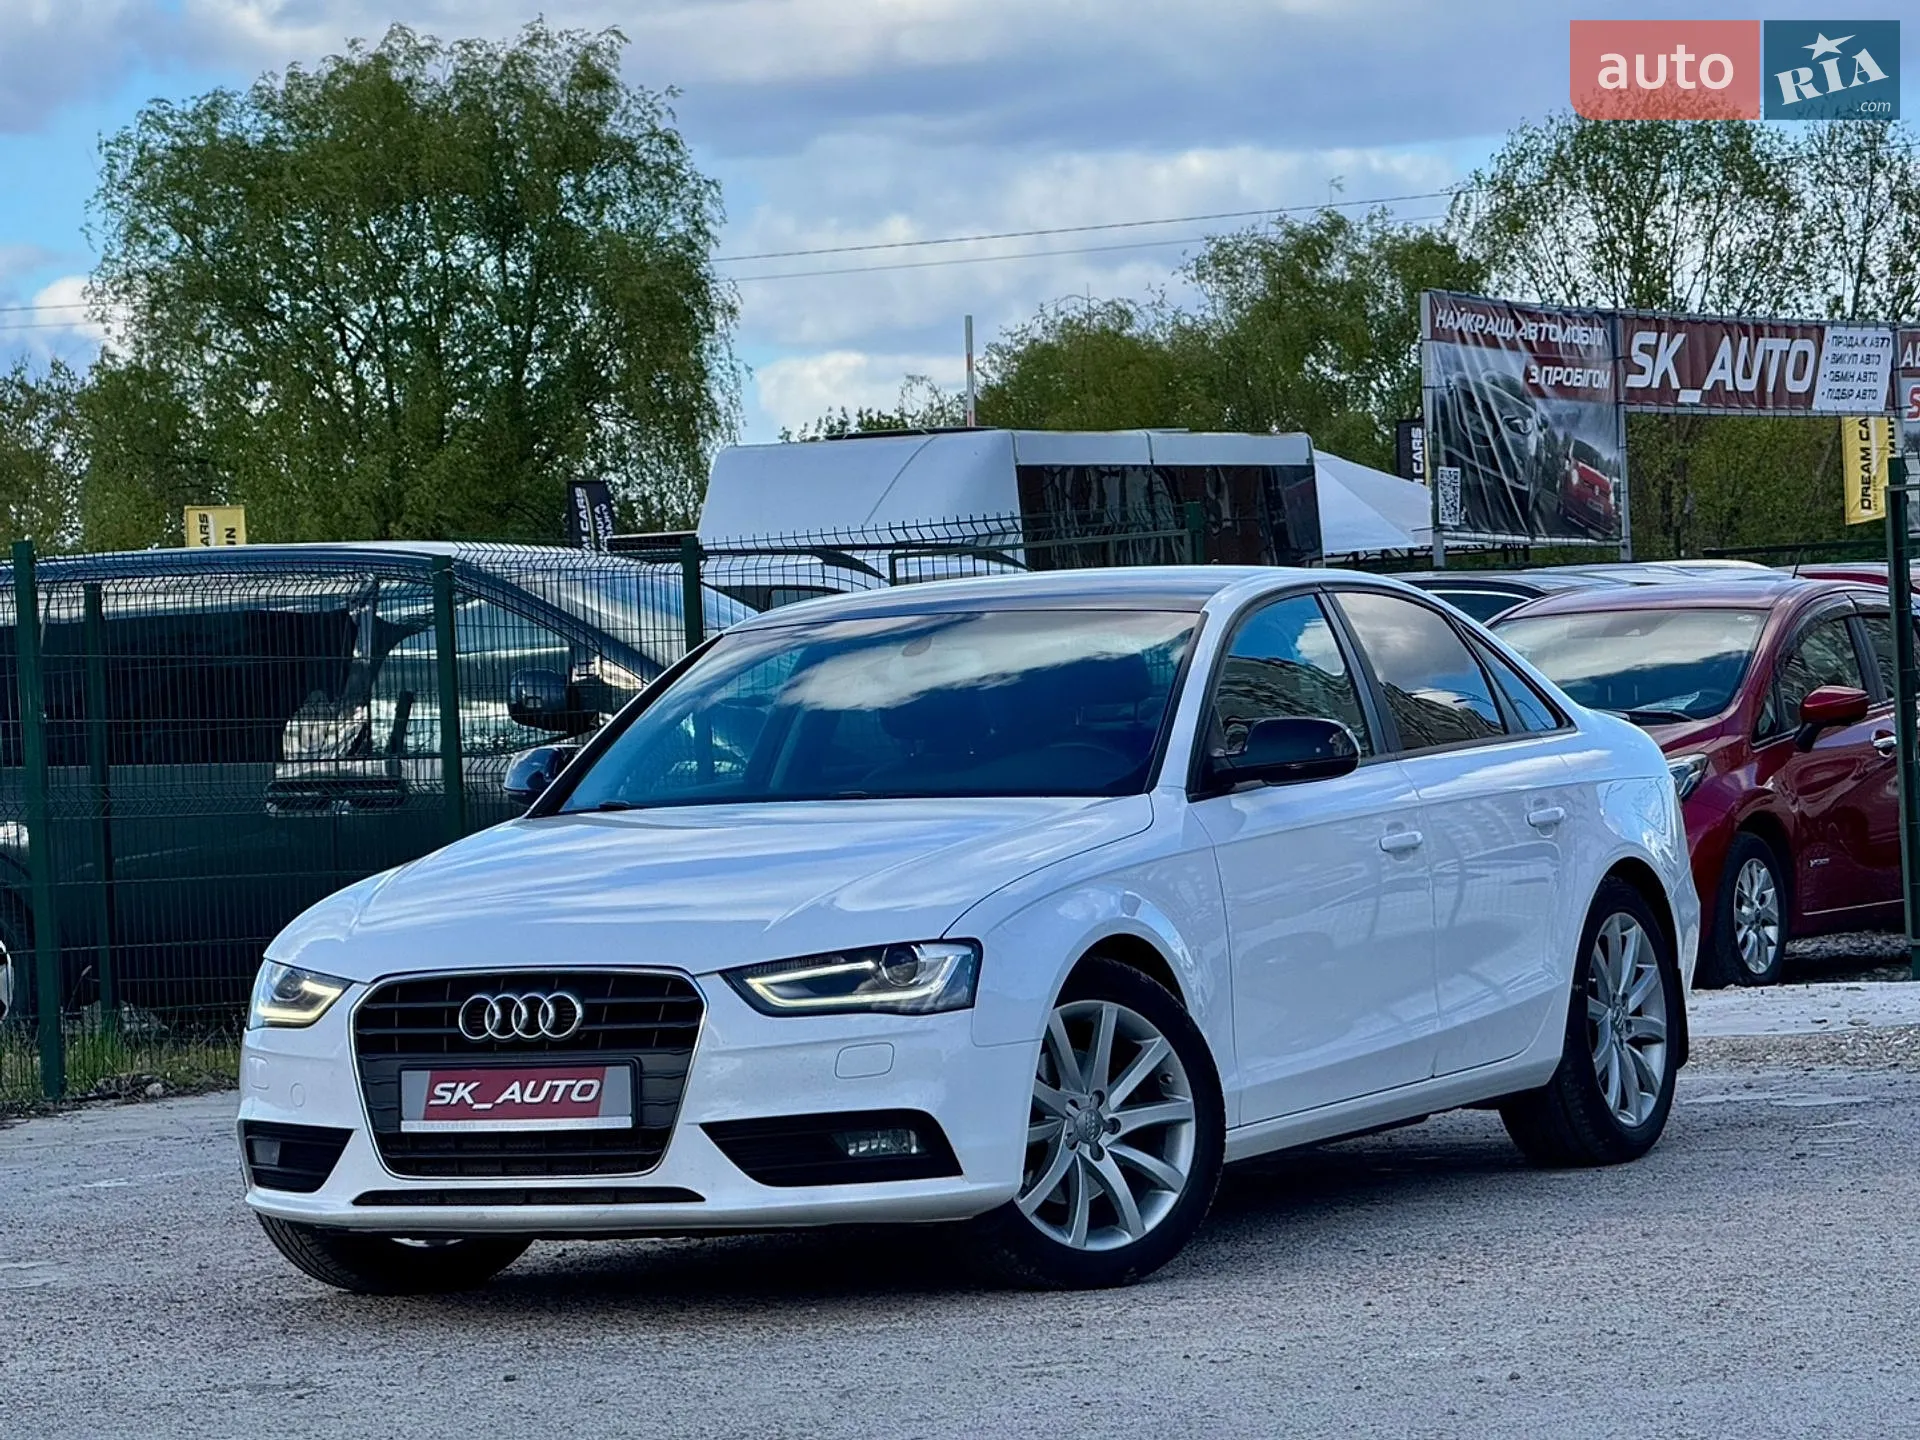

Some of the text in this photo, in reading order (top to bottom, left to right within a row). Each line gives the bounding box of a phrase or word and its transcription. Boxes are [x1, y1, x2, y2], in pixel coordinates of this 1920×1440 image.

[1435, 307, 1515, 341] НАЙКРАЩІ
[1625, 330, 1816, 403] SK_AUTO
[1830, 353, 1881, 365] ВИКУП АВТО
[1527, 365, 1612, 389] З ПРОБІГОМ
[1856, 371, 1878, 382] АВТО
[1855, 388, 1878, 400] АВТО
[1411, 427, 1425, 474] CARS
[1860, 446, 1872, 510] DREAM
[574, 487, 589, 532] CARS
[428, 1079, 601, 1110] SK_AUTO
